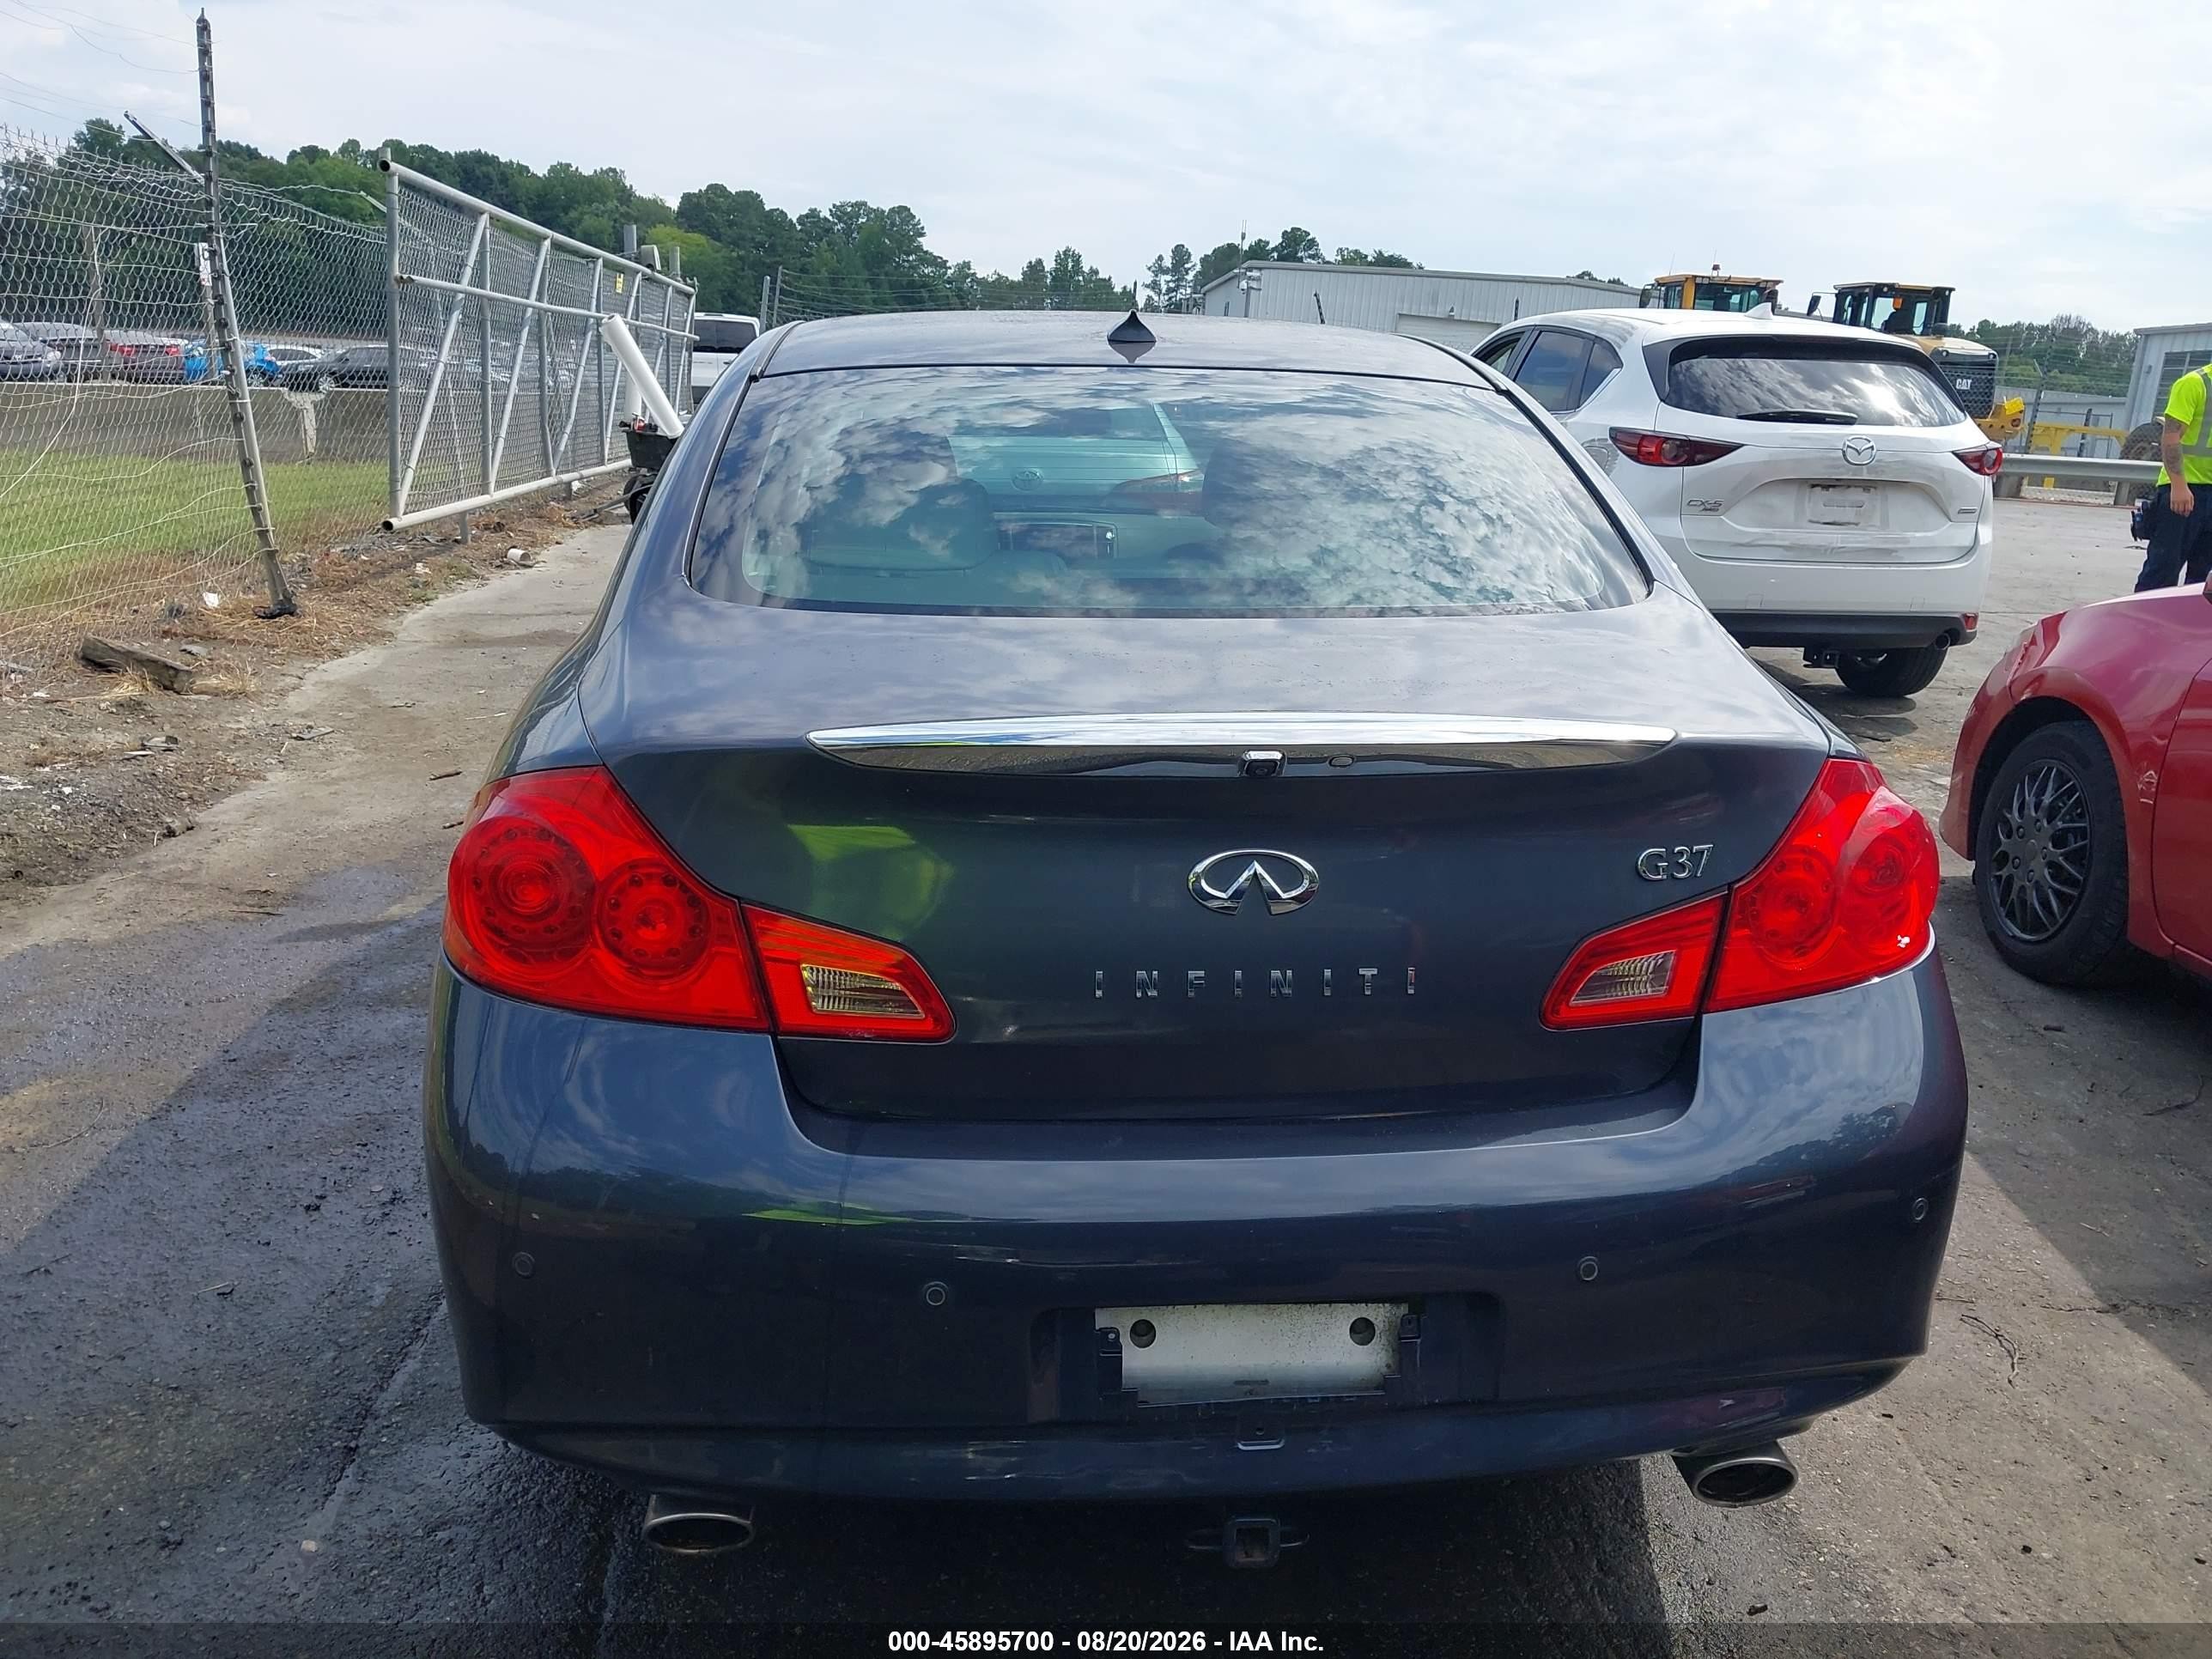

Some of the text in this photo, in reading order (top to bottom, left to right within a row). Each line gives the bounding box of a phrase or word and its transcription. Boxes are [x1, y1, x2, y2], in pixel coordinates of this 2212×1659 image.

[1956, 379, 1972, 390] CAT
[1638, 844, 1714, 880] G37
[1095, 967, 1416, 998] INFINITI
